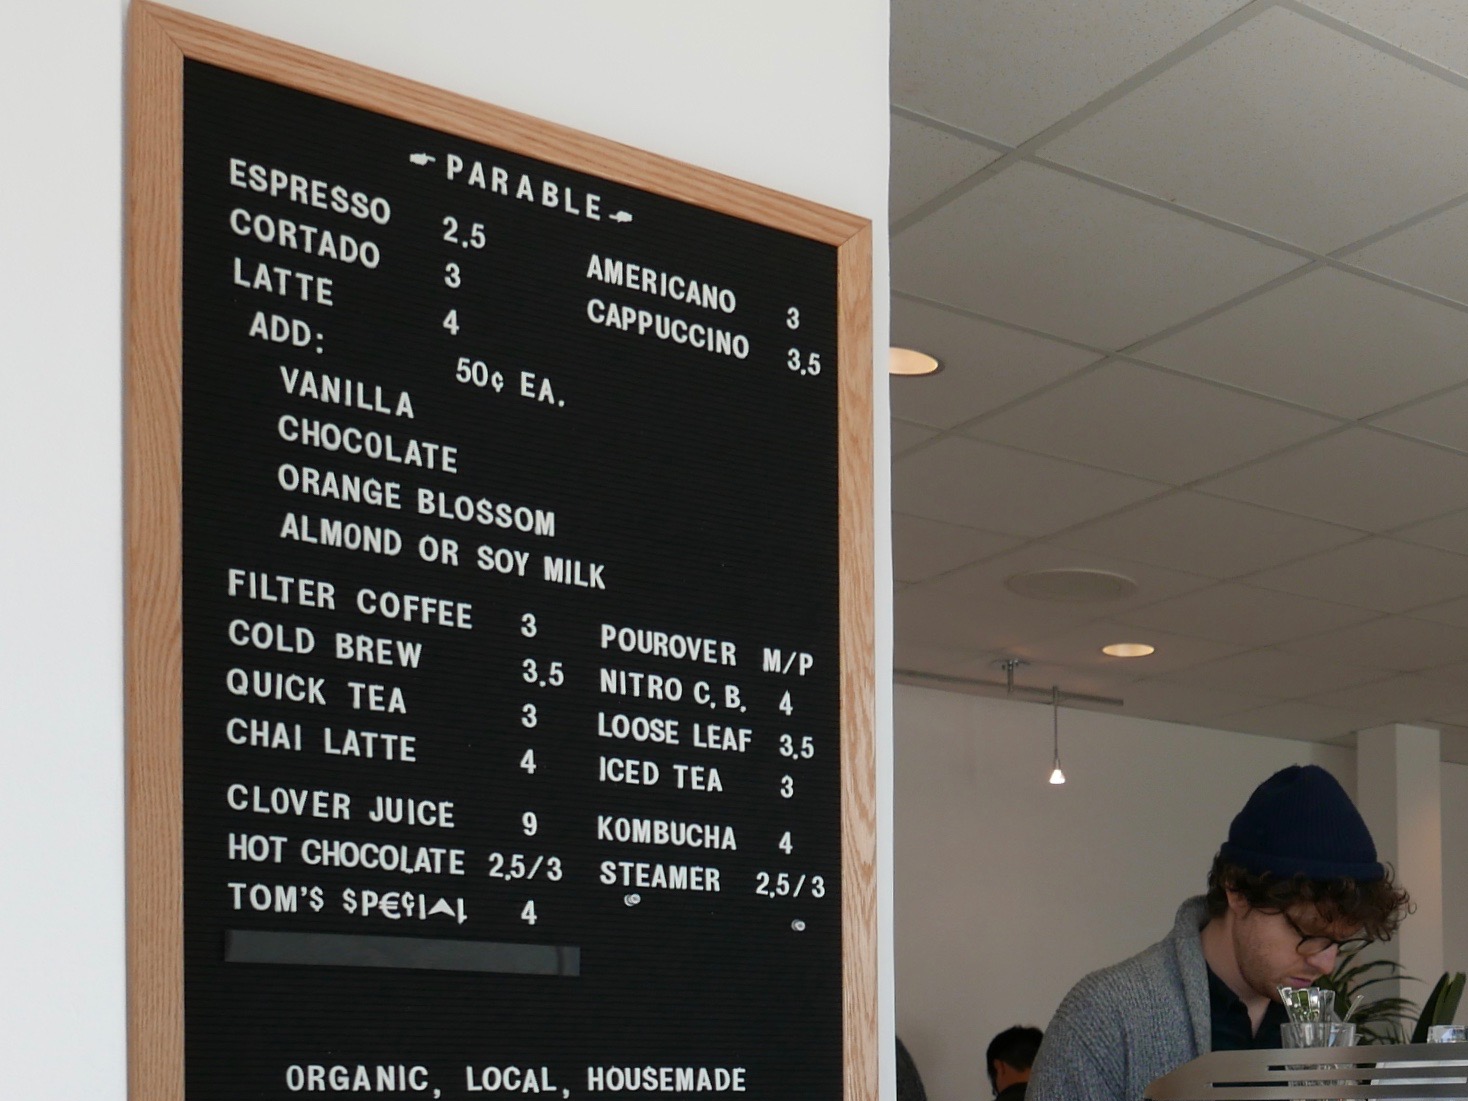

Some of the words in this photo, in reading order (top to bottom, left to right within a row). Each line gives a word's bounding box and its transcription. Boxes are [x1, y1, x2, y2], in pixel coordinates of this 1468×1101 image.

[230, 158, 390, 225] ESPRESSO
[442, 215, 486, 249] 2.5
[446, 153, 601, 221] PARABLE
[230, 208, 380, 269] CORTADO
[444, 262, 461, 289] 3
[234, 257, 333, 307] LATTE
[442, 309, 460, 336] 4
[587, 254, 736, 314] AMERICANO
[786, 306, 800, 330] 3
[248, 311, 324, 354] ADD:
[520, 370, 565, 408] EA.
[587, 299, 749, 359] CAPPUCCINO
[787, 347, 821, 376] 3.5
[279, 365, 415, 419] VANILLA
[277, 414, 458, 474] CHOCOLATE
[277, 463, 402, 510] ORANGE
[417, 487, 555, 538] BLOSSOM
[280, 512, 402, 556] ALMOND
[418, 534, 459, 567] OR
[477, 544, 530, 577] SOY
[543, 555, 606, 590] MILK
[228, 568, 336, 610] FILTER
[356, 588, 473, 630] COFFEE
[520, 612, 538, 638] 3
[228, 618, 315, 654] COLD
[335, 632, 423, 669] BREW
[522, 658, 565, 688] 3.5
[600, 623, 737, 667] POUROVER
[762, 647, 814, 676] M/P
[226, 667, 327, 706] QUICK
[347, 681, 407, 714] TEA
[521, 703, 538, 729] 3
[600, 667, 683, 702] NITRO
[778, 689, 794, 716] 4
[226, 717, 302, 751] CHAI
[324, 727, 417, 763] LATTE
[519, 748, 537, 775] 4
[598, 711, 680, 745] LOOSE
[693, 722, 753, 753] LEAF
[779, 733, 815, 760] 3.5
[599, 755, 660, 786] ICED
[672, 764, 723, 792] TEA
[780, 774, 794, 799] 3
[226, 783, 351, 820] CLOVER
[368, 795, 455, 828] JUICE
[521, 811, 538, 837] 9
[597, 815, 737, 851] KOMBUCHA
[778, 831, 794, 855] 4
[228, 832, 288, 863] HOT
[300, 838, 465, 876] CHOCOLATE
[599, 860, 721, 892] STEAMER
[520, 899, 538, 926] 4
[286, 1064, 441, 1099] ORGANIC,
[466, 1065, 570, 1099] LOCAL,
[587, 1065, 746, 1092] HOUSEMADE
